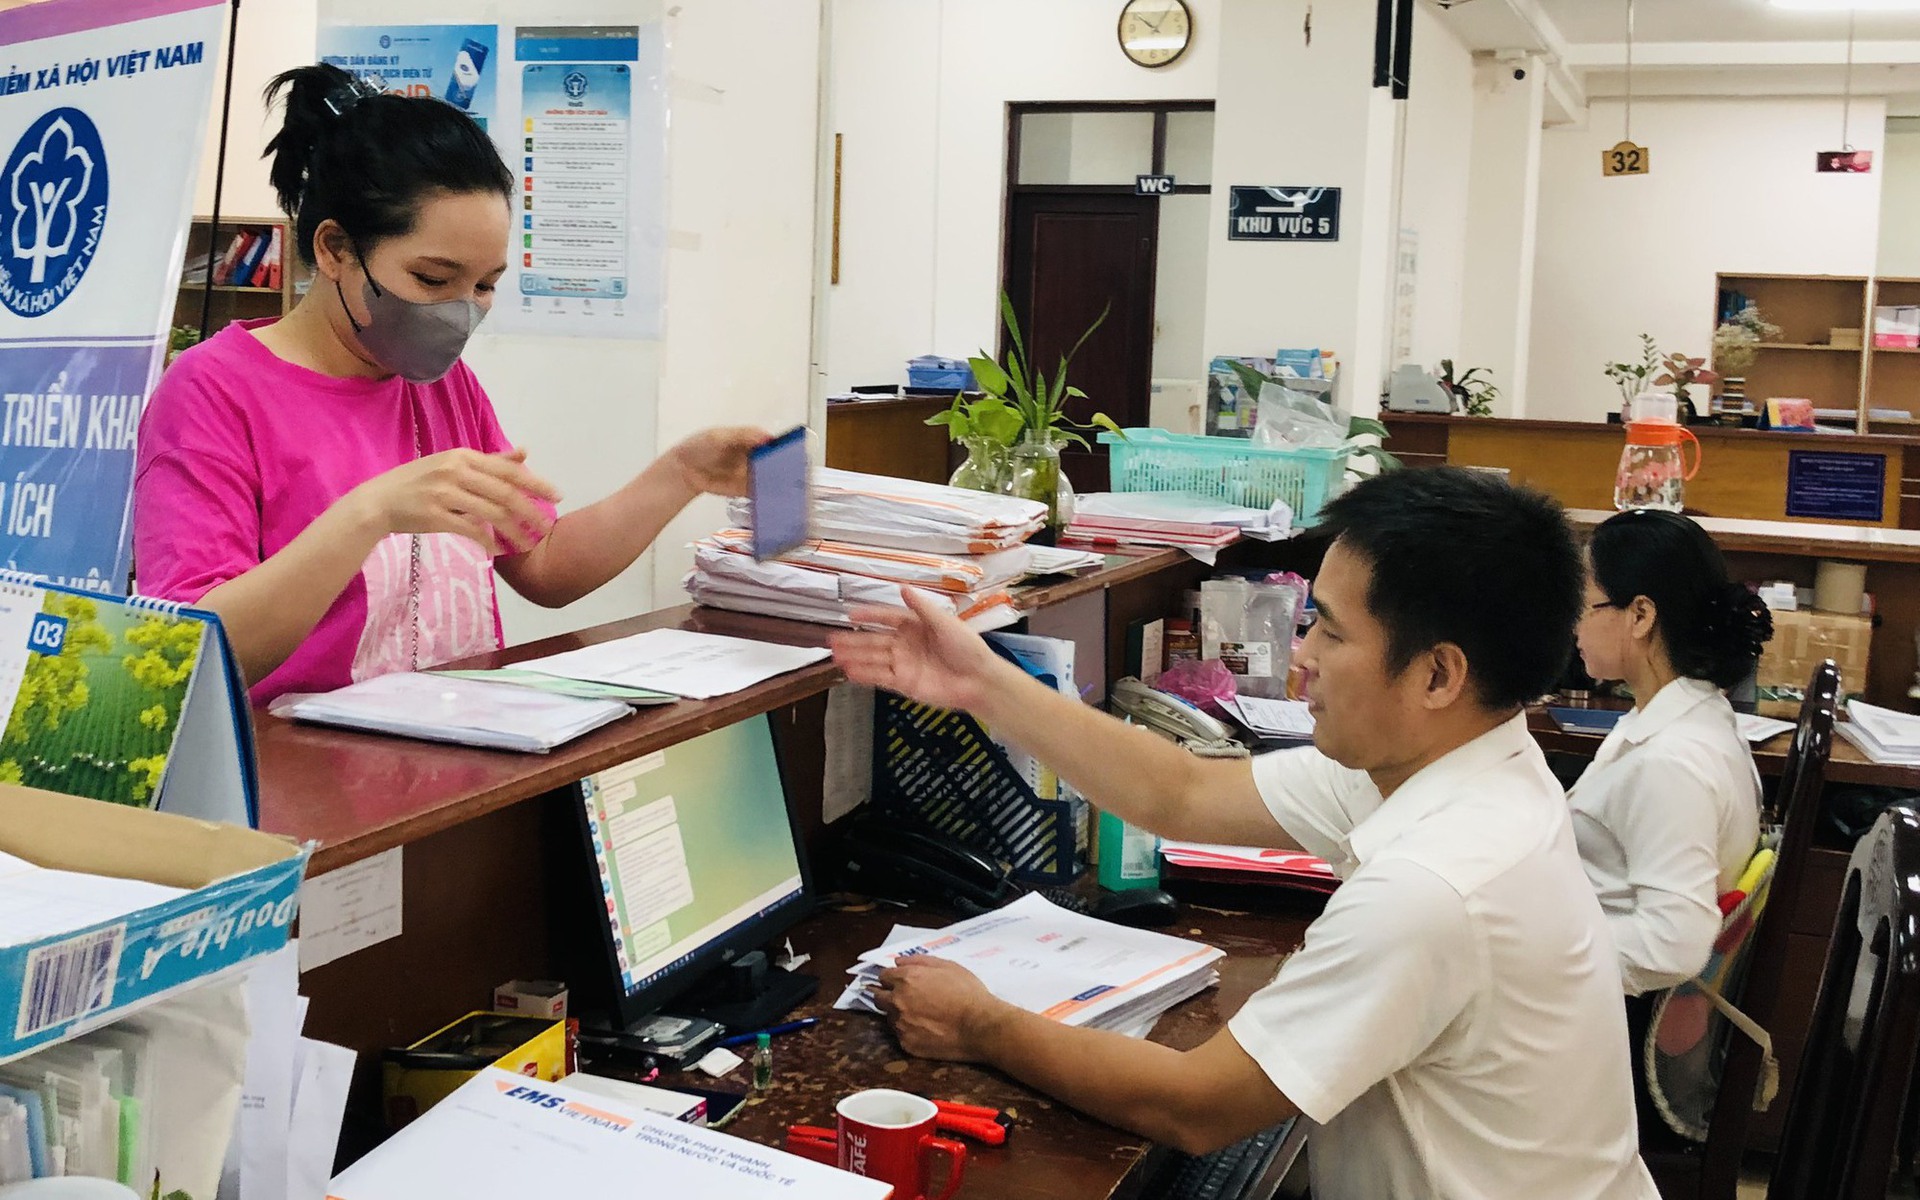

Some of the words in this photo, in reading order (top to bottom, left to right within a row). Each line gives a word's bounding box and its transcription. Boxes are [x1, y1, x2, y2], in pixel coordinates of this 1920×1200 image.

[35, 63, 60, 90] XÃ
[66, 58, 100, 86] HỘI
[107, 50, 151, 79] VIỆT
[155, 41, 204, 70] NAM
[1611, 151, 1641, 172] 32
[1140, 179, 1171, 193] WC
[81, 204, 106, 256] NAM
[1238, 216, 1272, 234] KHU
[1278, 213, 1314, 238] VỰC
[1318, 217, 1331, 235] 5
[2, 371, 82, 449] TRIỂN
[7, 471, 56, 538] ÍCH
[33, 620, 63, 648] 03
[180, 894, 295, 960] Double
[140, 940, 168, 980] A
[505, 1086, 566, 1109] EMS
[558, 1105, 627, 1133] VIETNAM
[847, 1131, 867, 1178] AFÉ
